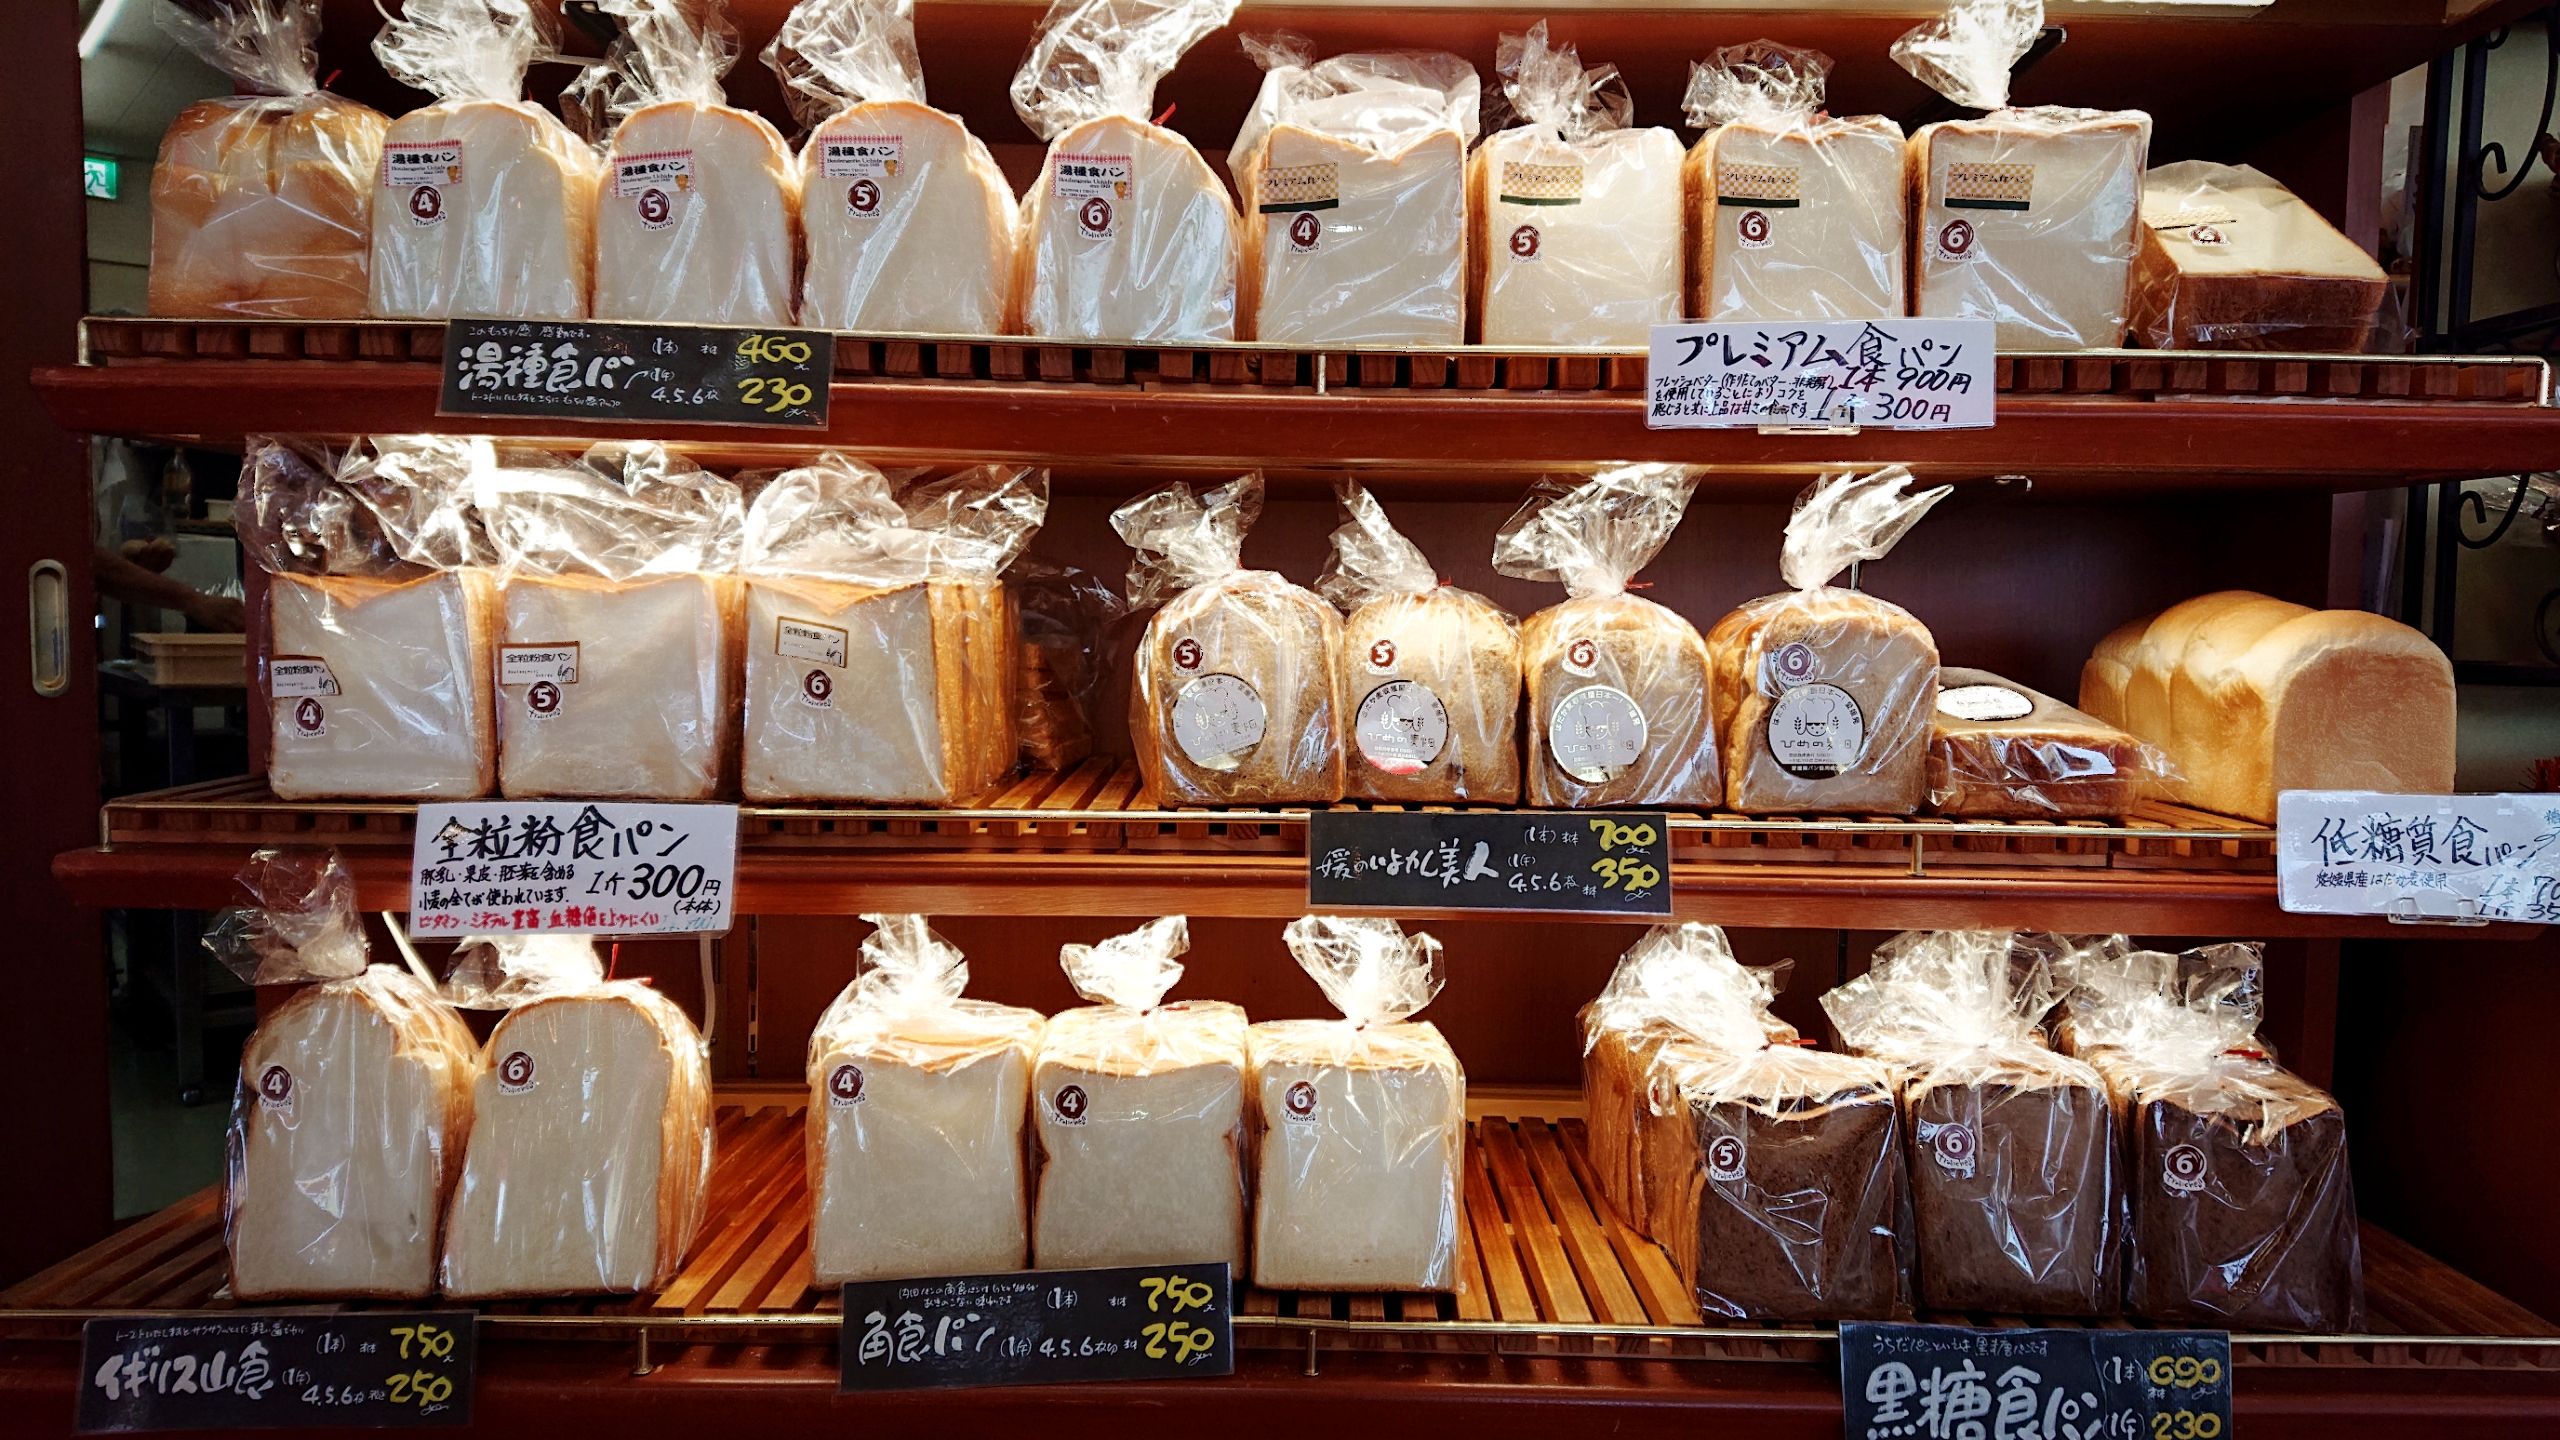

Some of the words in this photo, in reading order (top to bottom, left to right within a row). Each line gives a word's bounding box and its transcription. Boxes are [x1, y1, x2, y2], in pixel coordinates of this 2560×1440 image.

[391, 151, 456, 165] 湯種食パン
[827, 146, 895, 157] 湯種食パン
[621, 161, 686, 177] 湯種食パン
[1059, 164, 1125, 178] 湯種食パン
[417, 193, 433, 212] 4
[854, 185, 871, 207] 5
[645, 197, 662, 218] 5
[1087, 204, 1103, 226] 6
[1297, 220, 1312, 241] 4
[1746, 217, 1762, 237] 6
[1946, 227, 1964, 248] 6
[1515, 231, 1532, 253] 5
[1675, 321, 1963, 373] プレミアム食パン
[457, 340, 650, 394] 湯種食パン
[1838, 366, 1886, 393] 1本
[1896, 366, 1973, 396] 900円
[737, 377, 813, 413] 230
[1871, 395, 1952, 424] 300円
[504, 652, 572, 663] 全粒粉食パン
[1180, 643, 1195, 665] 5
[1374, 643, 1392, 664] 5
[1573, 644, 1591, 664] 6
[1787, 649, 1804, 671] 6
[811, 675, 826, 695] 6
[534, 687, 552, 708] 5
[301, 704, 316, 725] 4
[432, 804, 691, 863] 全粒粉食パン
[1589, 818, 1658, 852] 700
[2310, 811, 2539, 870] 低糖質食パン
[586, 871, 626, 897] 1斤
[628, 862, 722, 900] 300円
[1590, 856, 1661, 893] 350
[673, 900, 721, 917] (本体)
[508, 1059, 525, 1080] 6
[267, 1073, 283, 1095] 4
[838, 1072, 854, 1092] 4
[1063, 1092, 1078, 1112] 4
[1293, 1087, 1308, 1108] 6
[1946, 1132, 1963, 1154] 6
[1719, 1146, 1733, 1165] 5
[2176, 1153, 2194, 1175] 6
[1139, 1274, 1214, 1314] 750
[389, 1322, 455, 1360] 750
[858, 1311, 997, 1368] 角食パン
[1141, 1320, 1216, 1365] 250
[95, 1340, 274, 1401] イギリス山食
[2147, 1355, 2222, 1389] 690
[385, 1368, 454, 1408] 250
[1864, 1357, 2104, 1440] 黒糖食パン
[2150, 1408, 2222, 1440] 230
